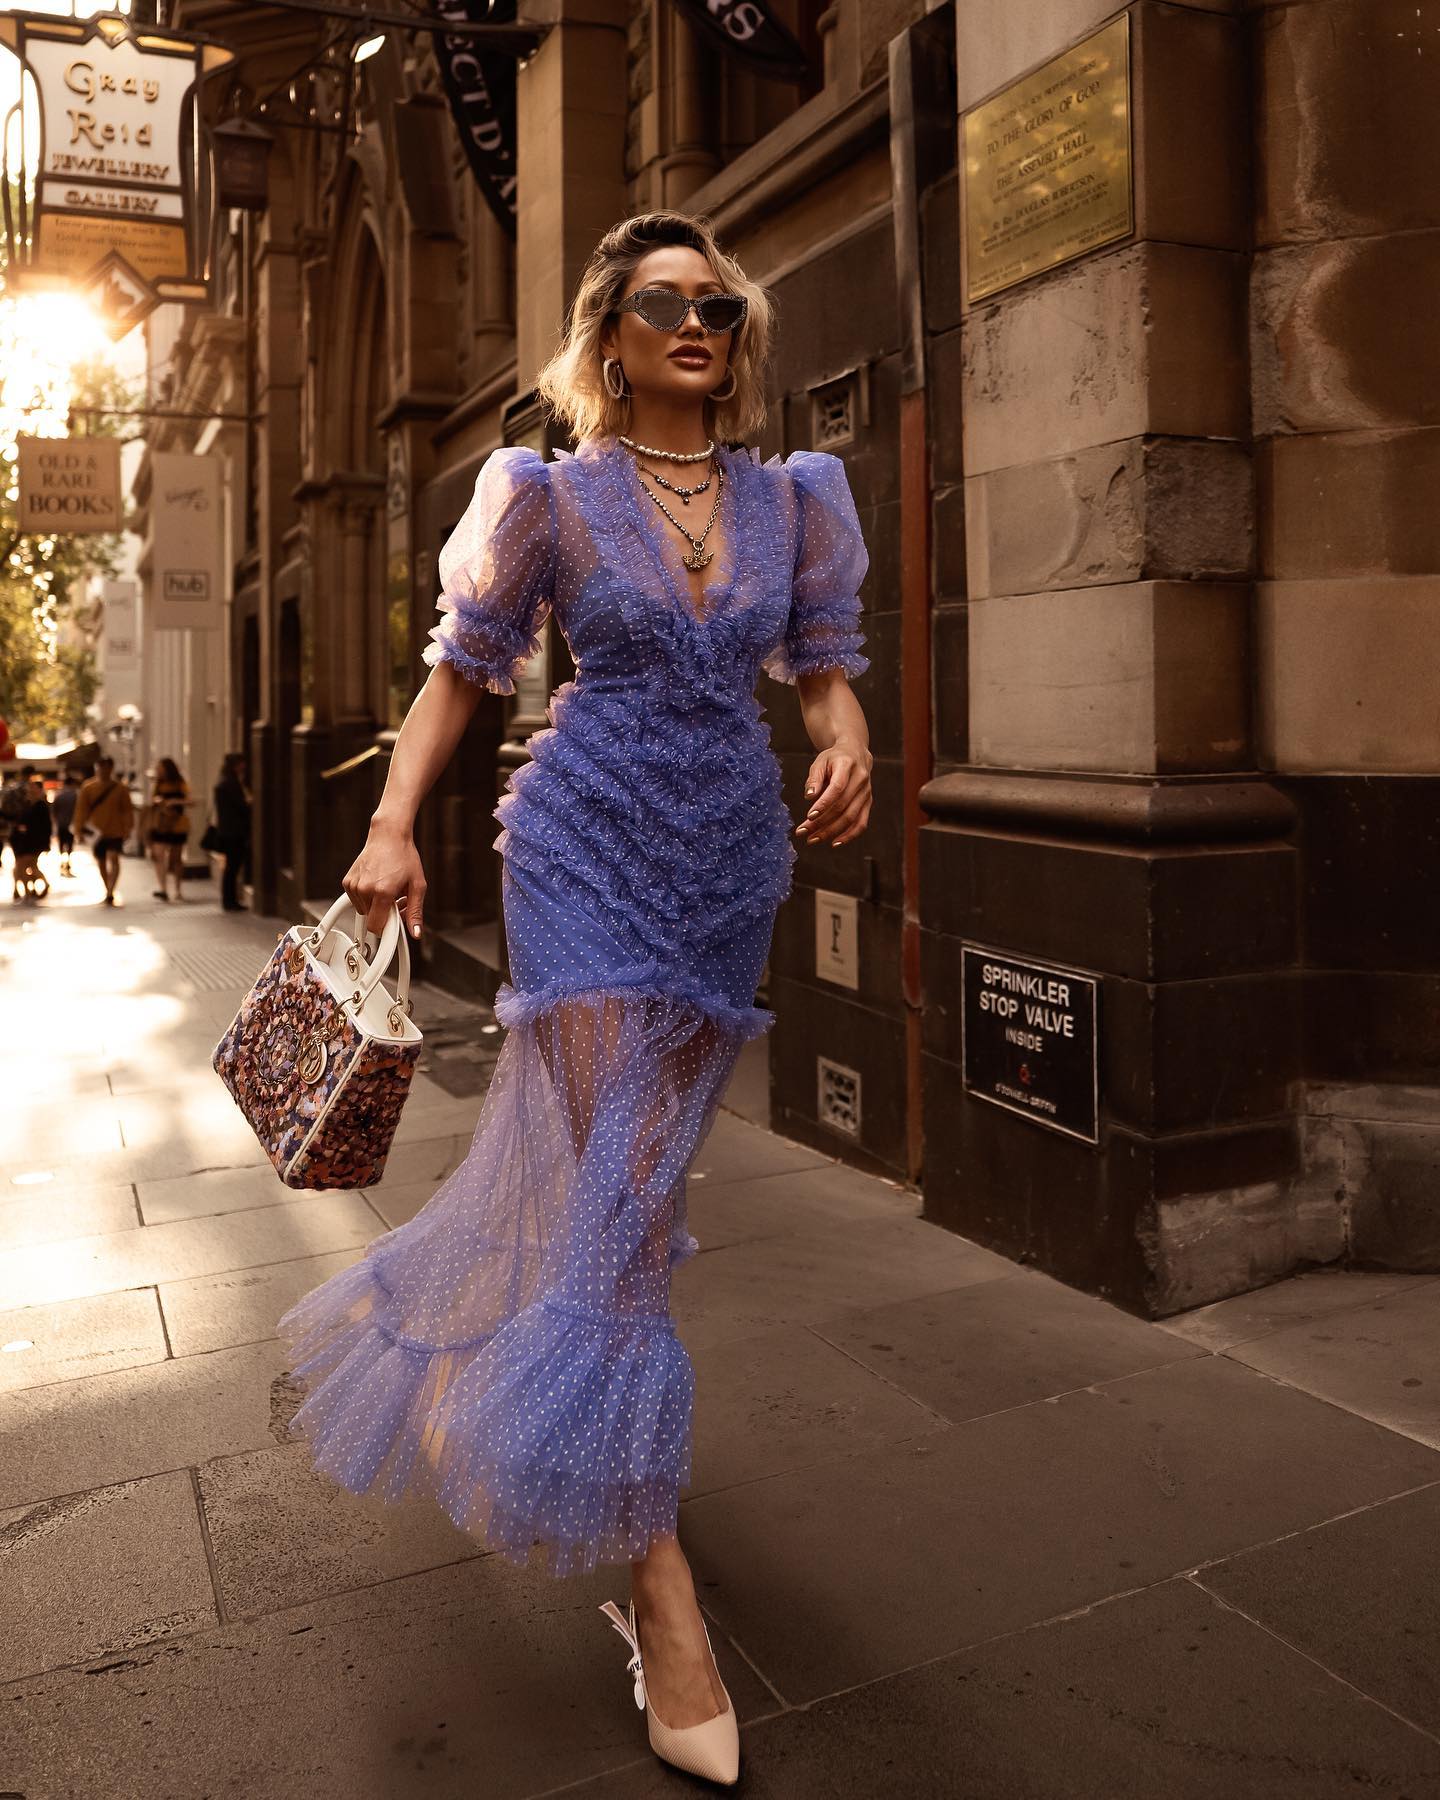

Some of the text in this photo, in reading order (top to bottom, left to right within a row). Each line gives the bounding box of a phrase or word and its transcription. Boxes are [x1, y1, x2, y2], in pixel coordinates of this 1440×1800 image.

[63, 60, 160, 104] Gray
[1024, 107, 1054, 133] GLORY
[1059, 95, 1073, 113] OF
[1076, 81, 1101, 104] GOD
[66, 109, 153, 150] Reid
[52, 153, 170, 181] JEWELLERY
[1018, 150, 1057, 177] ASSEMBLY
[1063, 133, 1088, 155] HALL
[64, 190, 159, 213] GALLERY
[38, 454, 97, 471] OLD &
[42, 473, 92, 489] RARE
[29, 494, 113, 516] BOOKS
[168, 575, 204, 594] hub
[982, 963, 1070, 1008] SPRINKLER
[979, 990, 1075, 1038] STOP VALVE
[1005, 1026, 1044, 1053] INSIDE
